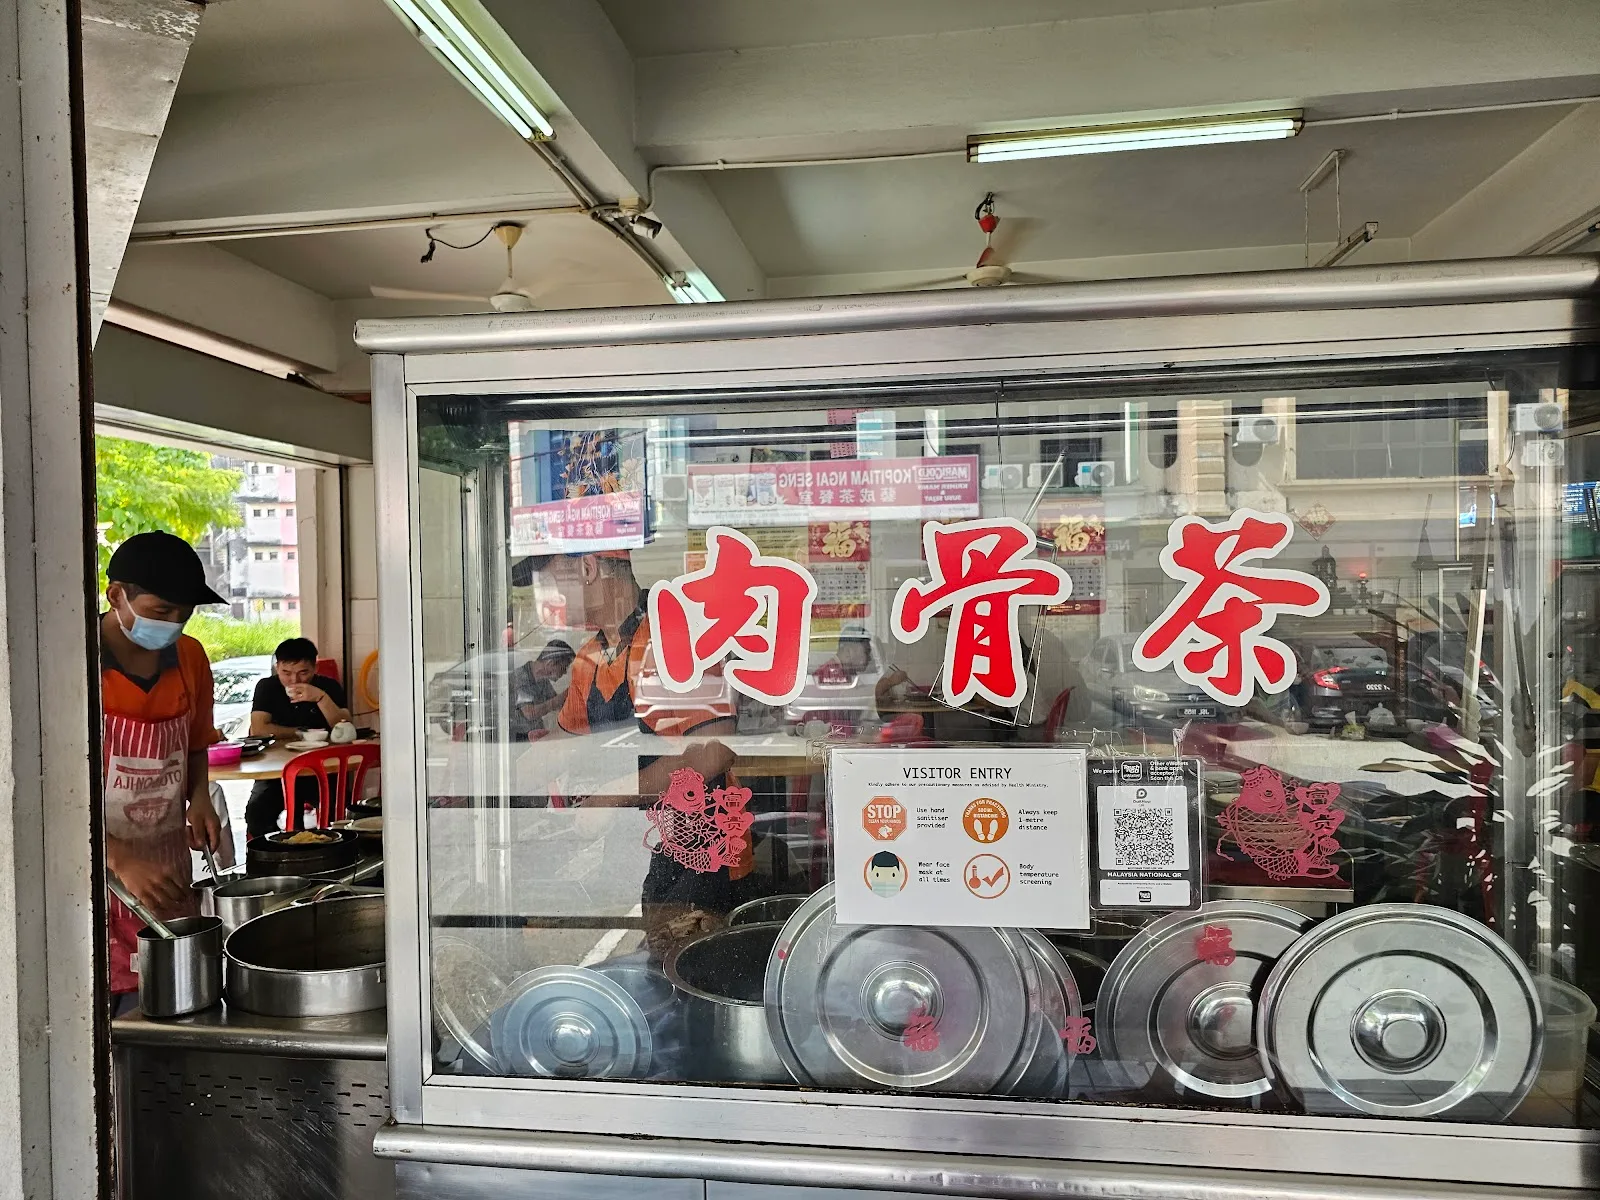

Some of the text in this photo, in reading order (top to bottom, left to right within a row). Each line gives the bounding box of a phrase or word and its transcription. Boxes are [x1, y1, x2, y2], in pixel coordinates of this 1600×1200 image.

[822, 521, 857, 558] 福
[653, 513, 1327, 704] 肉骨茶
[903, 768, 1012, 779] VISITOR ENTRY
[868, 804, 901, 818] STOP
